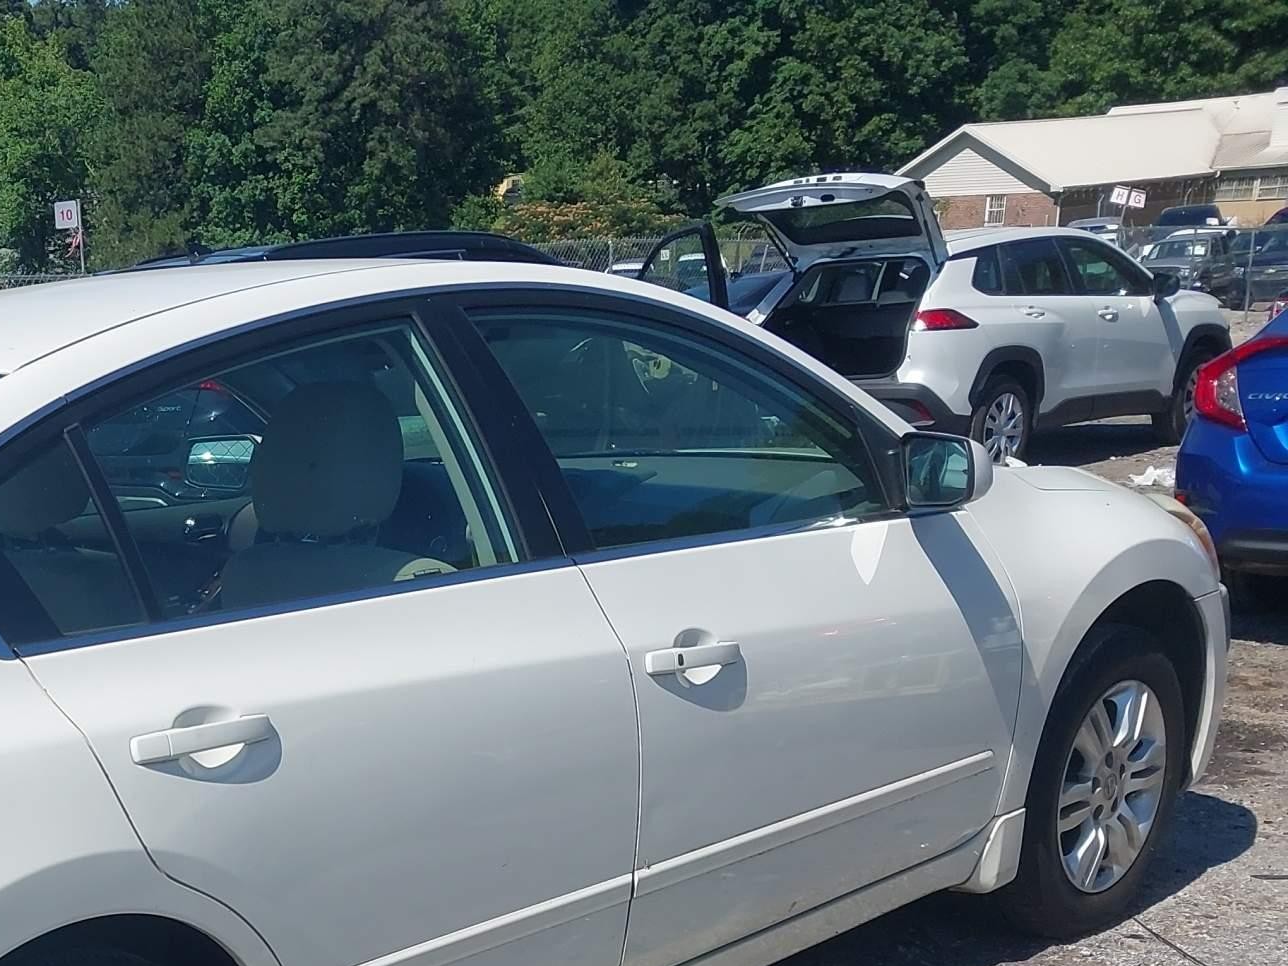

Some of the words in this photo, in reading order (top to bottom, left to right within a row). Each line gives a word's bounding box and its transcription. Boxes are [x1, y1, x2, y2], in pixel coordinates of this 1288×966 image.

[1115, 190, 1125, 201] H
[1133, 194, 1142, 204] G
[60, 208, 73, 221] 10
